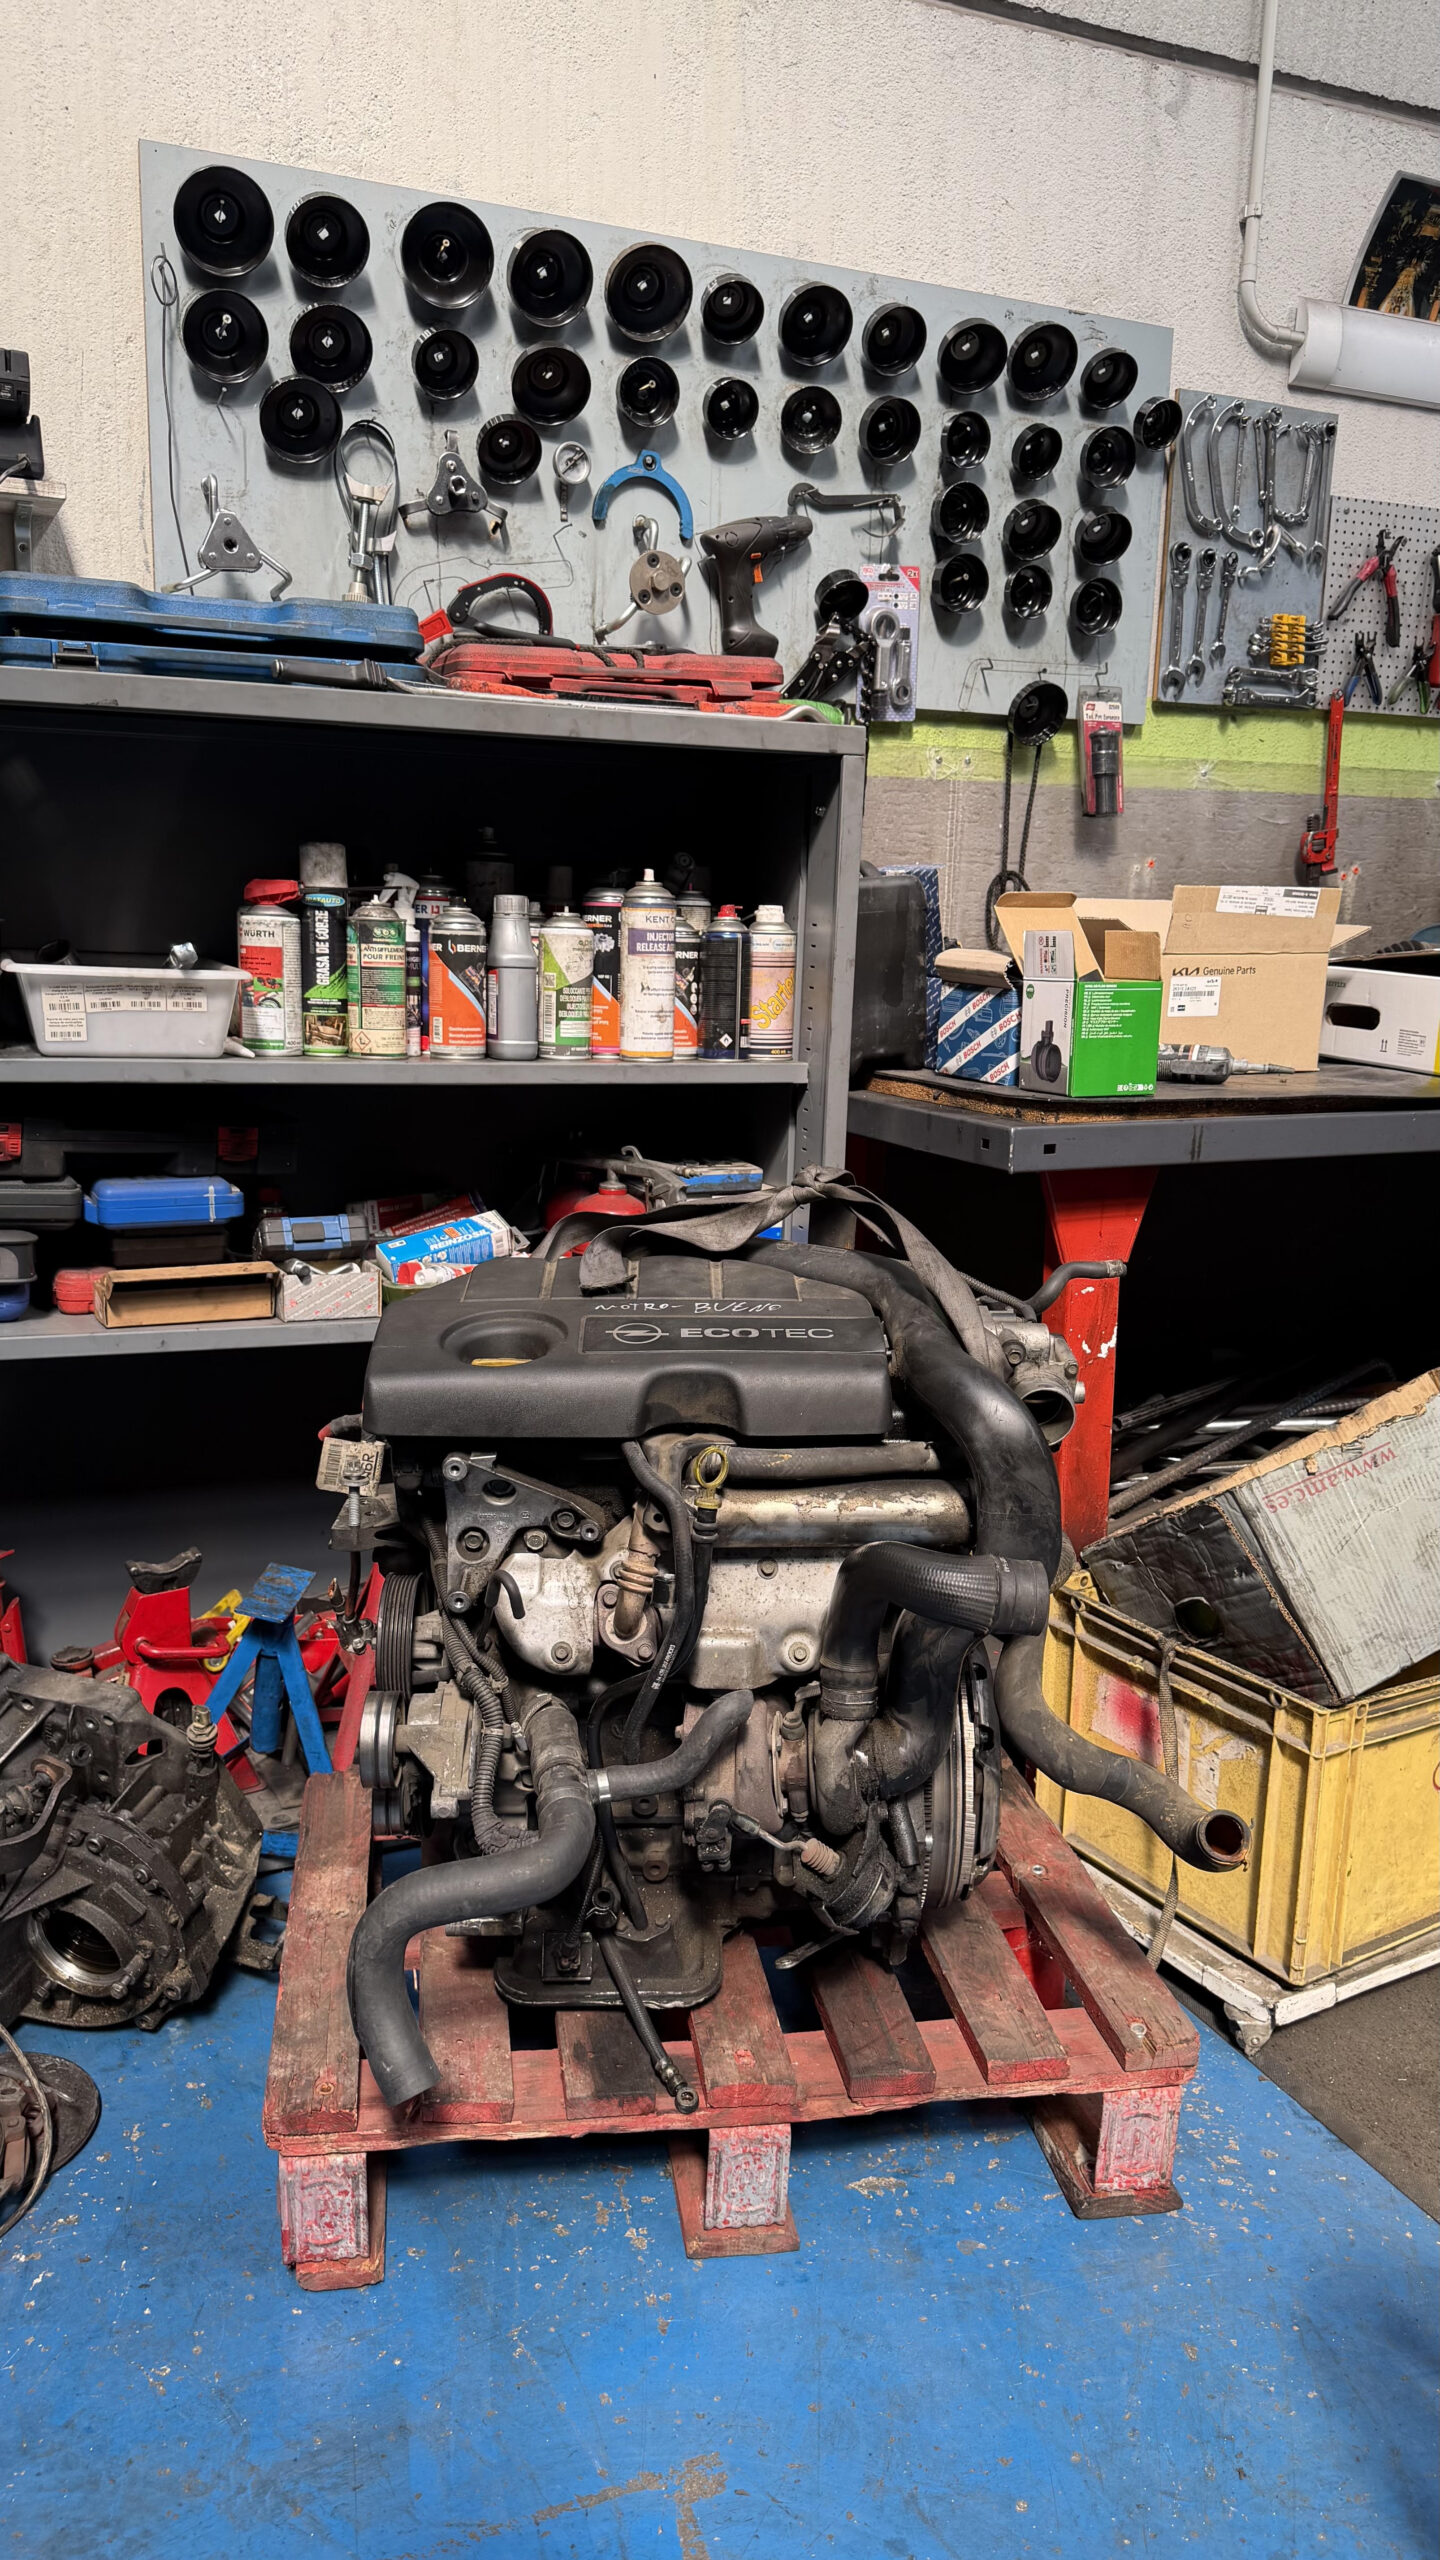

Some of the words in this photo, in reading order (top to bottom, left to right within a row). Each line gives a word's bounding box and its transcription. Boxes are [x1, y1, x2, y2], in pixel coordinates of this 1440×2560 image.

[907, 569, 918, 578] 2x
[583, 914, 613, 923] ERNER
[645, 915, 669, 924] KENT
[243, 929, 276, 938] WÜRTH
[315, 941, 330, 954] DE
[456, 944, 487, 953] BERNE
[675, 951, 699, 960] RNER
[316, 955, 330, 986] GRASA
[1203, 966, 1235, 976] Genuine
[1236, 966, 1256, 975] Parts
[972, 991, 991, 1010] BOSCH
[998, 1011, 1022, 1032] BOSCH
[939, 1020, 957, 1038] BOSCH
[962, 1041, 982, 1060] BOSCH
[989, 1061, 1010, 1081] BOSCH
[429, 1229, 490, 1251] REINZOSIL
[694, 1301, 783, 1313] BUENO
[680, 1327, 834, 1339] ECOTEC
[1264, 1446, 1398, 1514] www.amc.es
